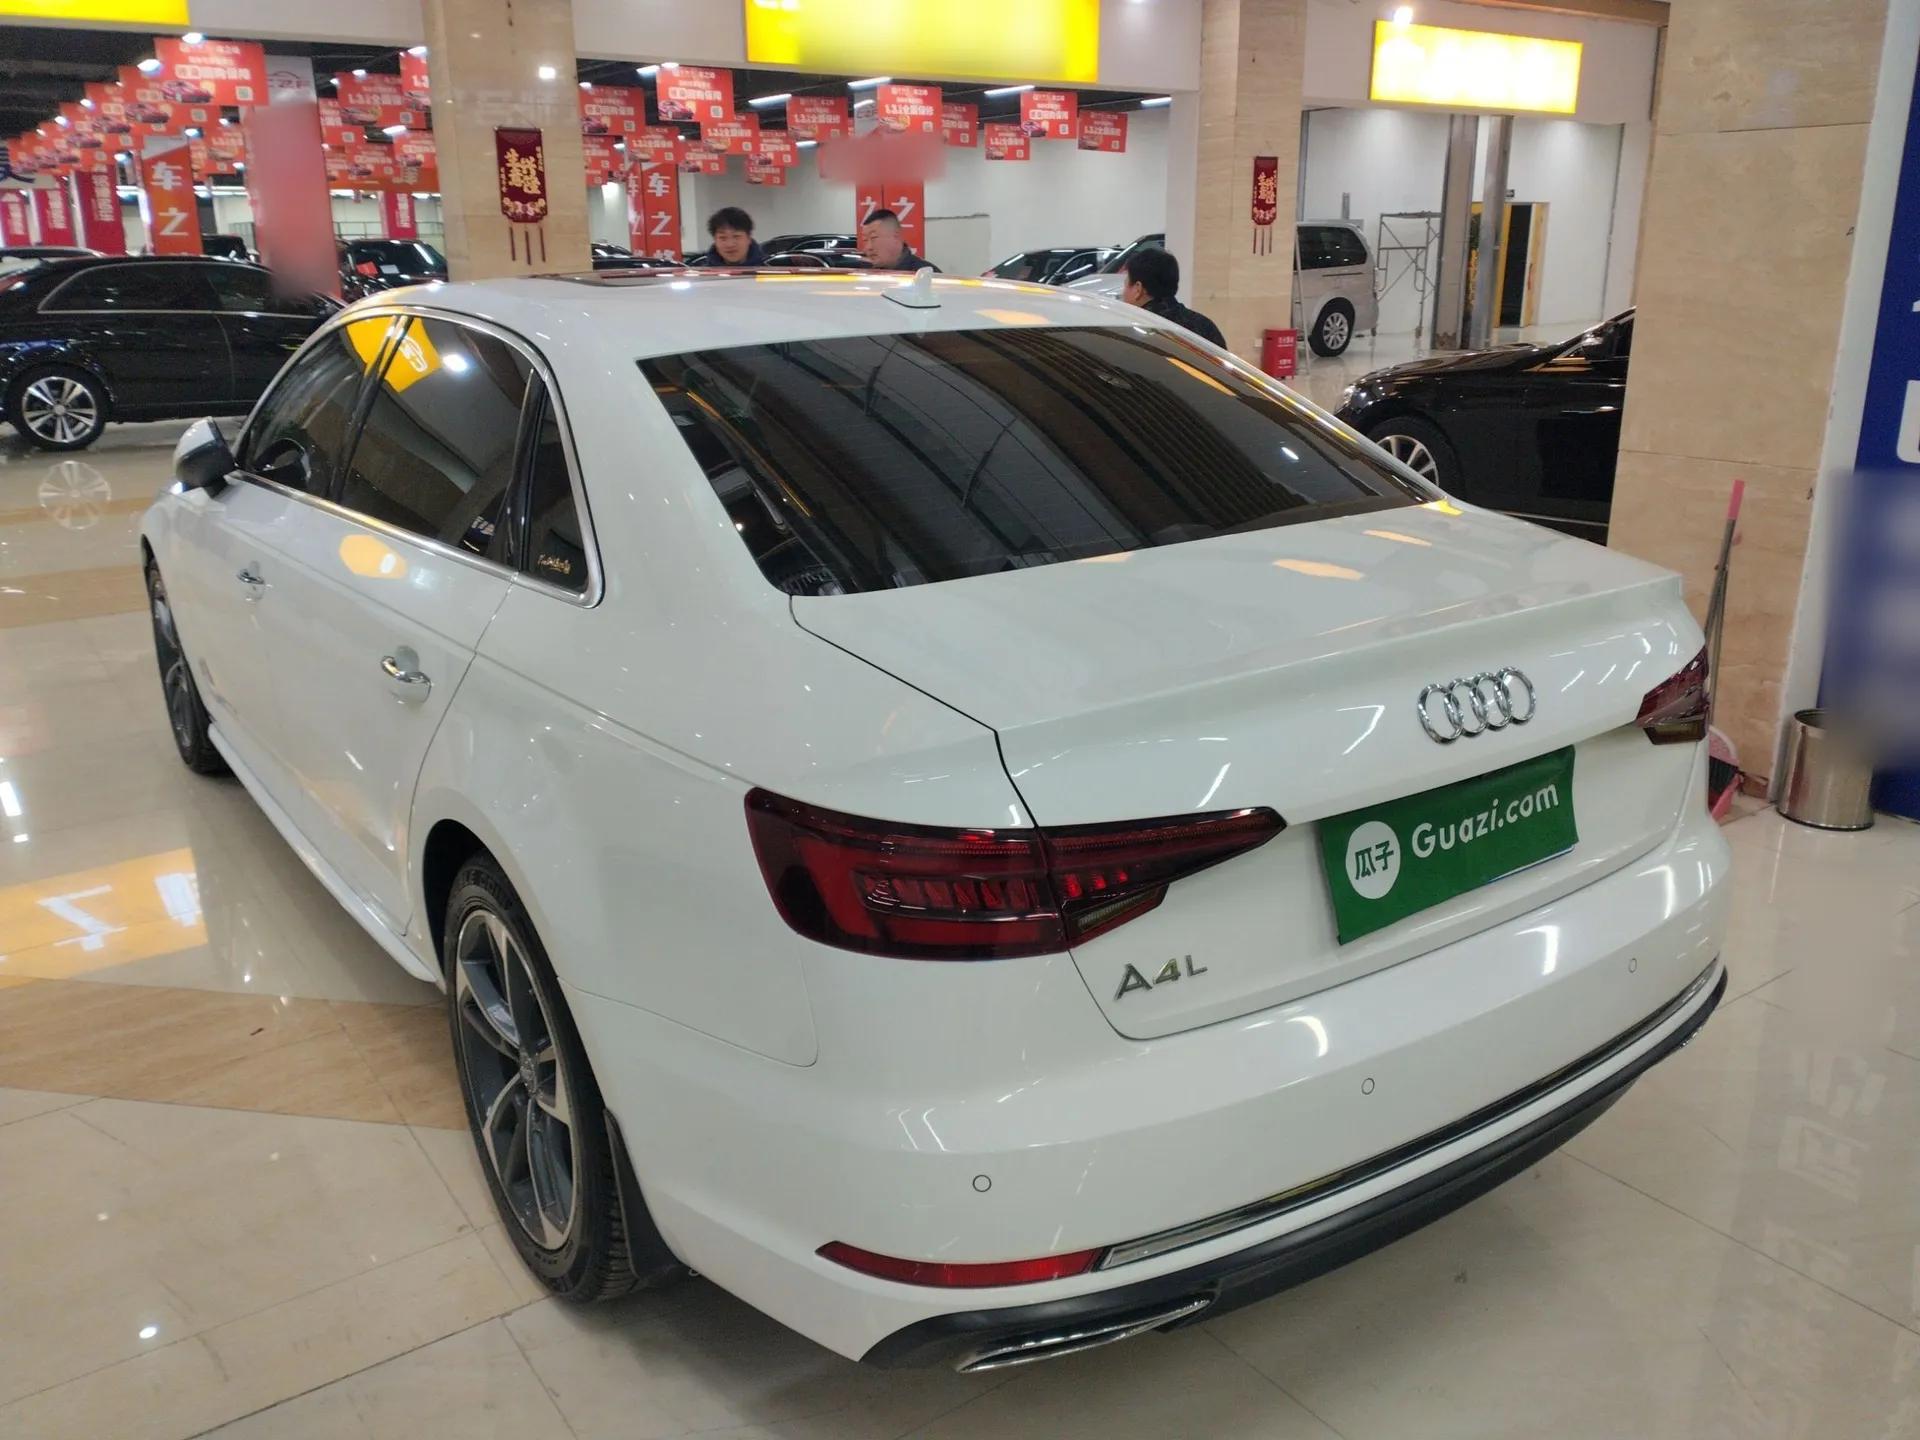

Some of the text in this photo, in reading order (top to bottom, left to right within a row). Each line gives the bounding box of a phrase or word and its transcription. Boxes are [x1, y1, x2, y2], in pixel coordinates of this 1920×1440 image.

[1354, 783, 1560, 881] 瓜子 Guazi.com
[1113, 953, 1208, 1001] A4L
